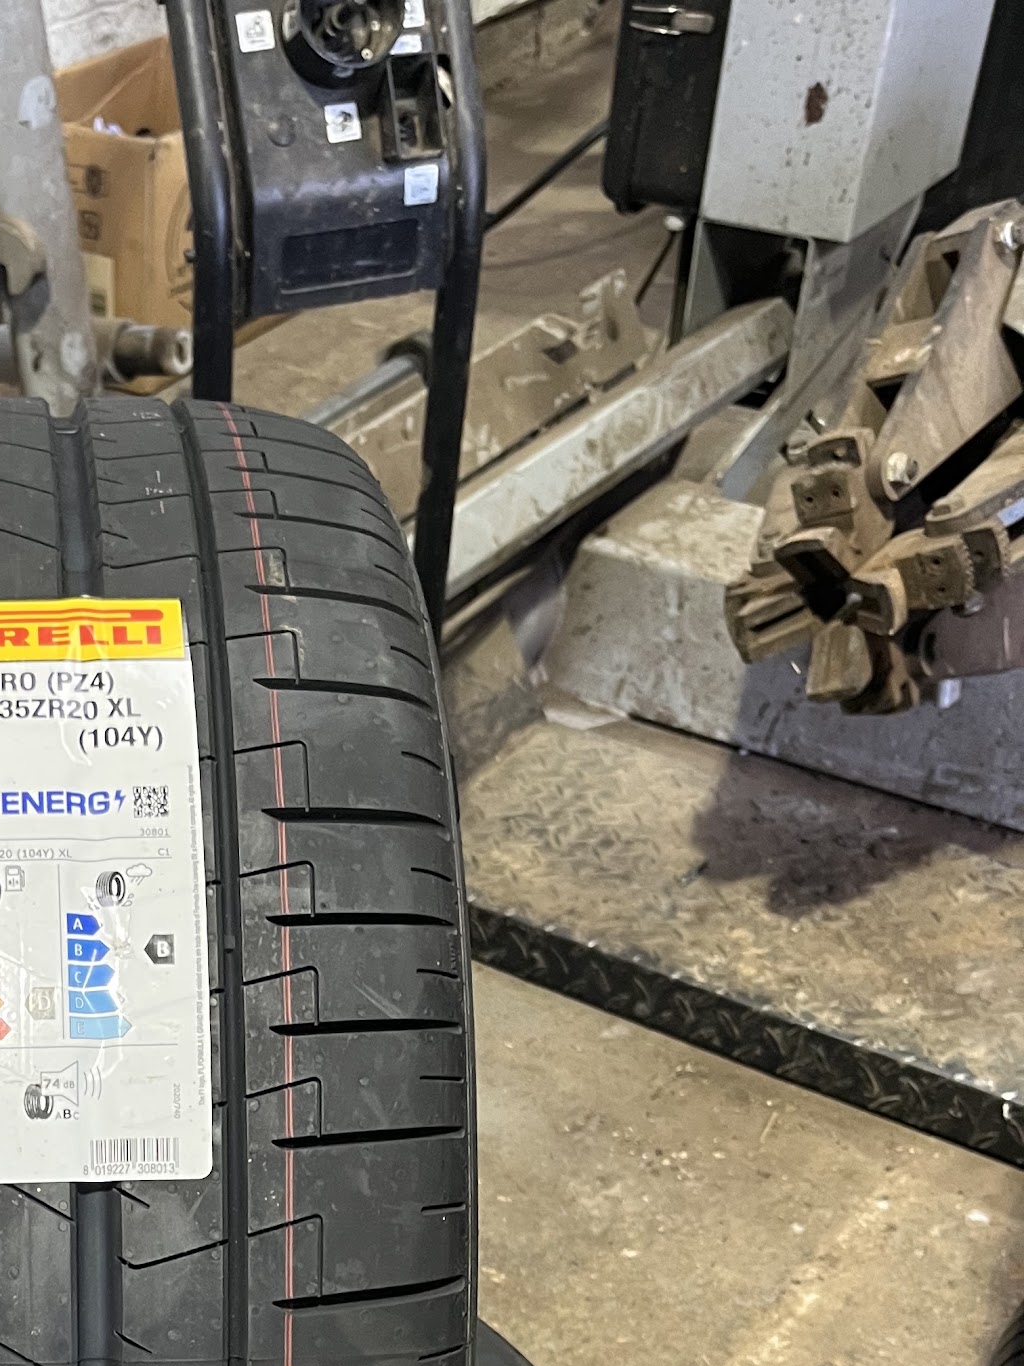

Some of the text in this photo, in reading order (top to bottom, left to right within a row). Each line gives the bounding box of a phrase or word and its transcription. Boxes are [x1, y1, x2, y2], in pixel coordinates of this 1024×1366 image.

[48, 671, 114, 695] (PZ4)
[107, 698, 141, 718] XL
[79, 726, 164, 752] (104Y)
[139, 828, 170, 837] 30801
[17, 848, 55, 861] (104Y)
[59, 848, 73, 858] XL
[157, 848, 170, 856] C1
[73, 917, 83, 931] A
[74, 943, 83, 956] B
[156, 940, 171, 958] B
[43, 1078, 75, 1089] 74 dB
[83, 1162, 175, 1176] 8 019227 308013
